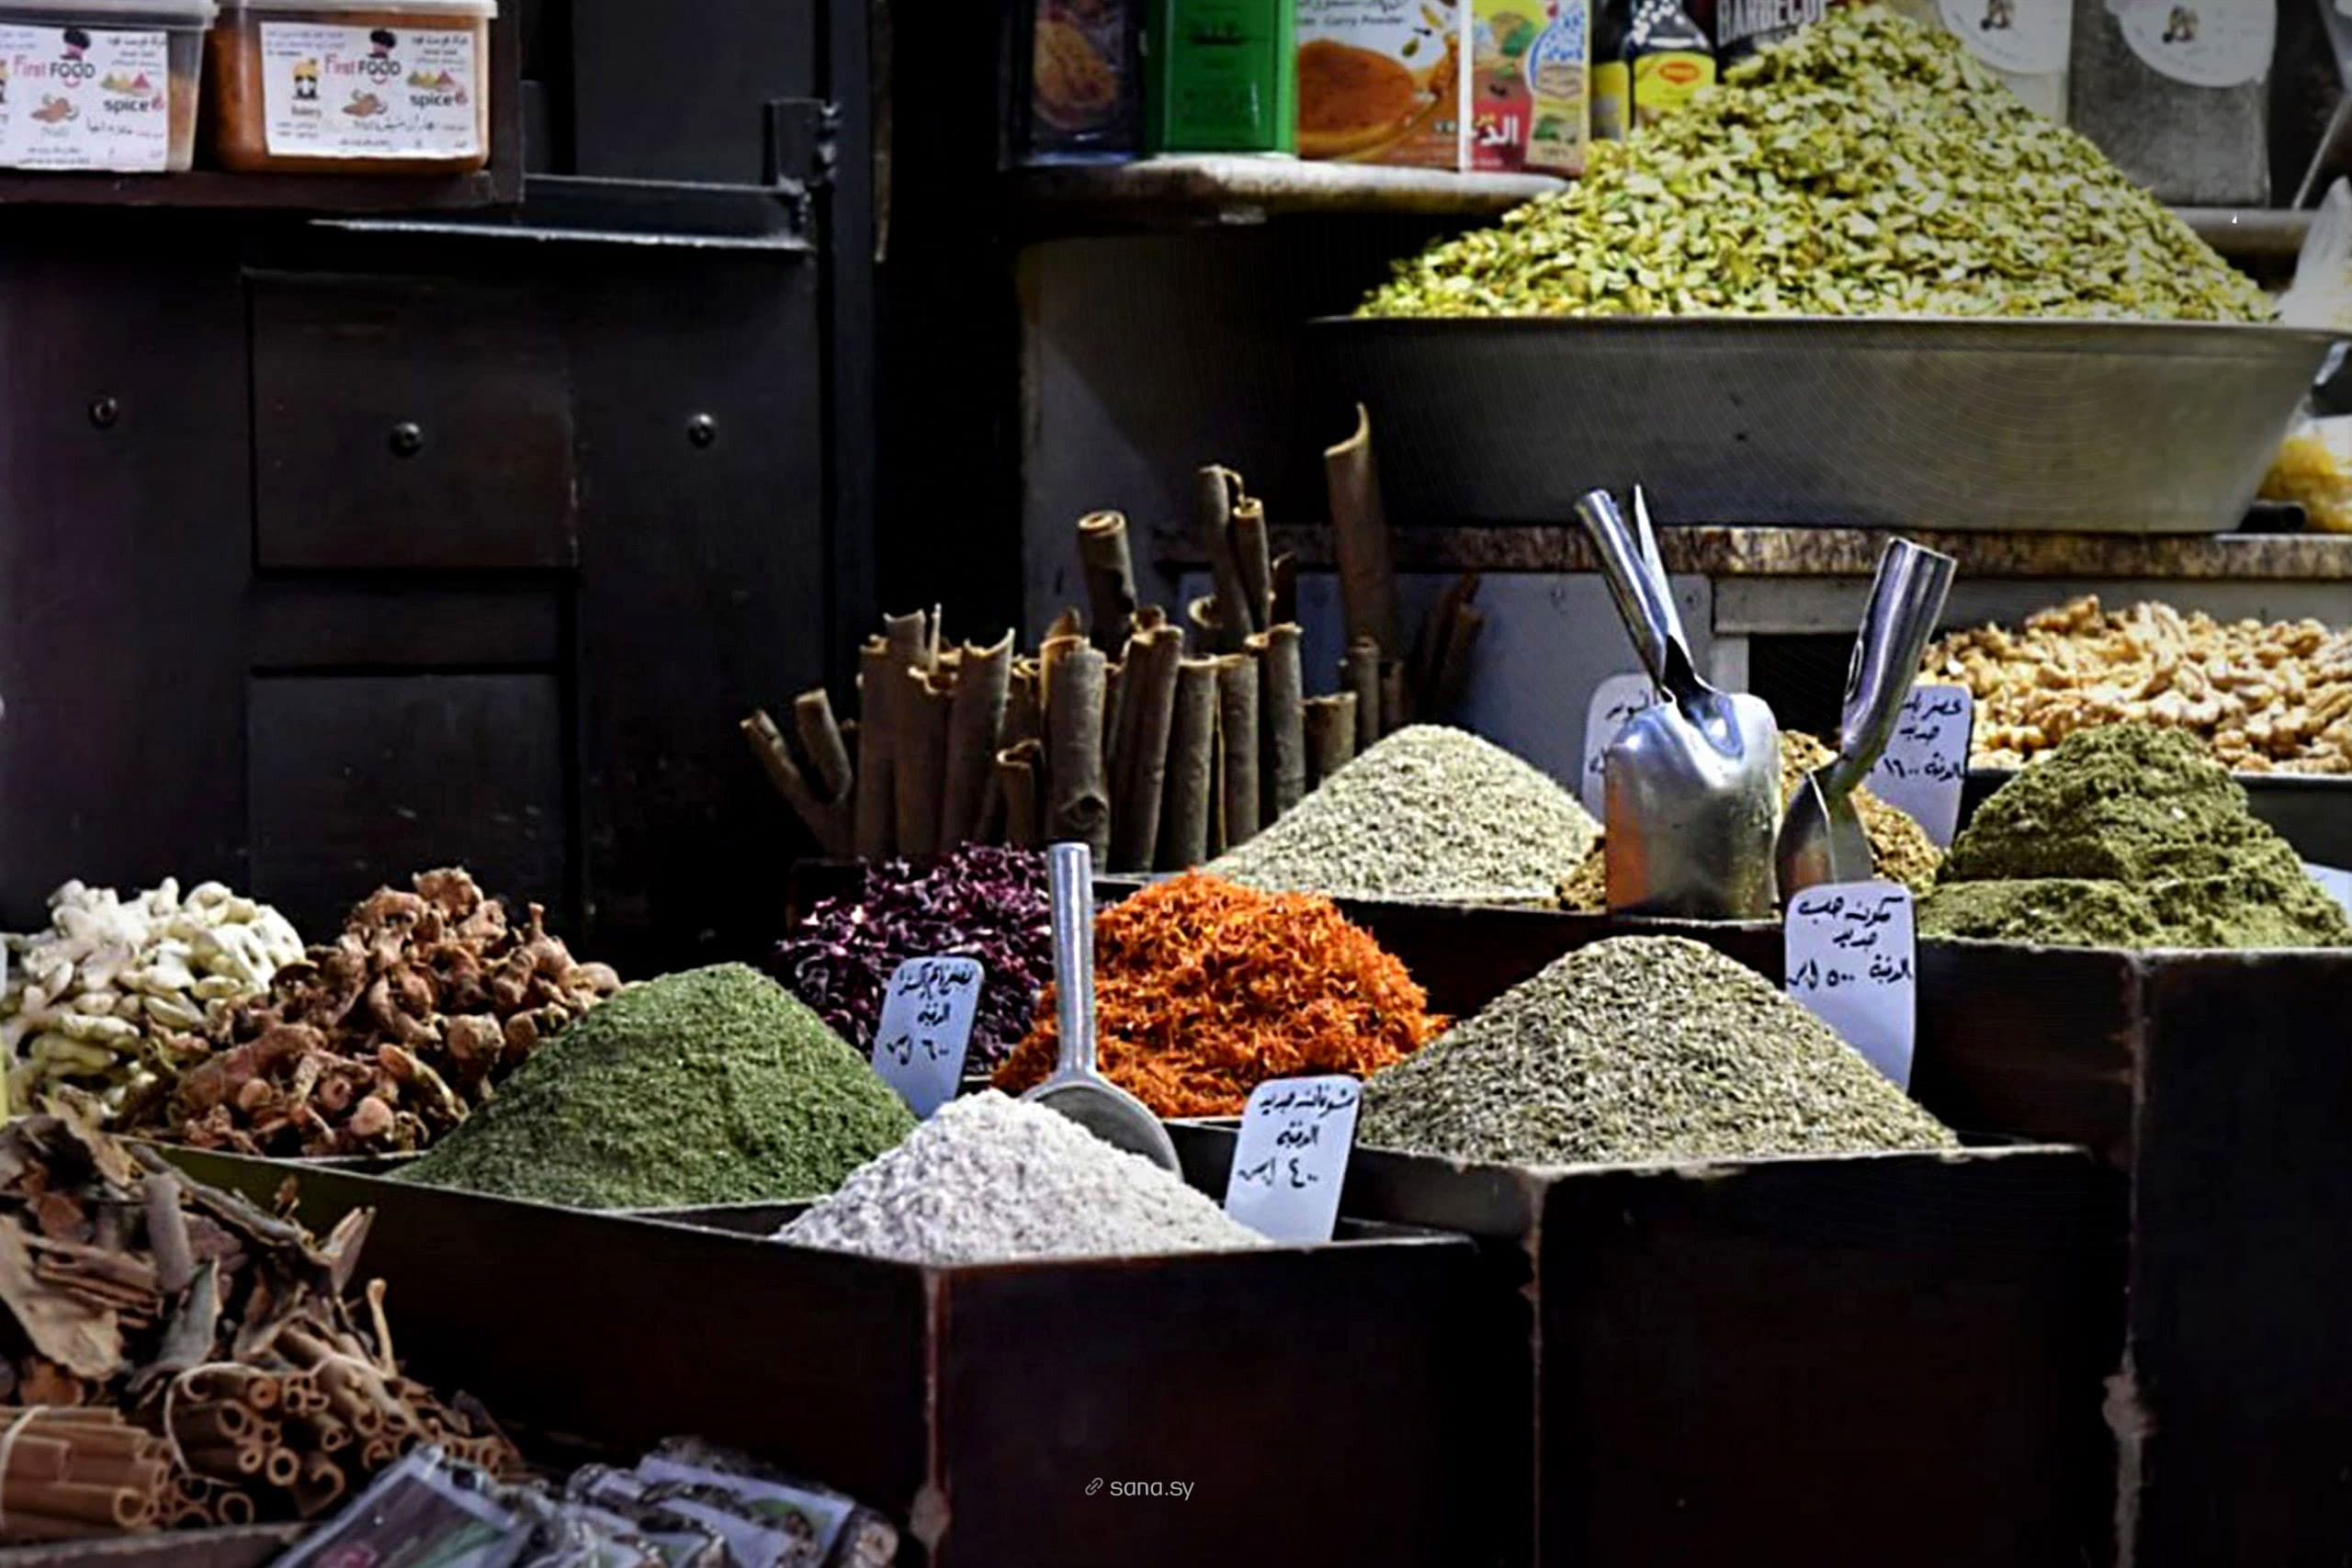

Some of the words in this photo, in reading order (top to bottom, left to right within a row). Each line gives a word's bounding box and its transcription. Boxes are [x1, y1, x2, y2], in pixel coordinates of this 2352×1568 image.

[14, 54, 46, 77] First
[50, 62, 96, 79] FOOD
[324, 52, 356, 74] First
[358, 61, 401, 76] FOOD
[103, 96, 150, 114] spice
[410, 93, 454, 109] spice
